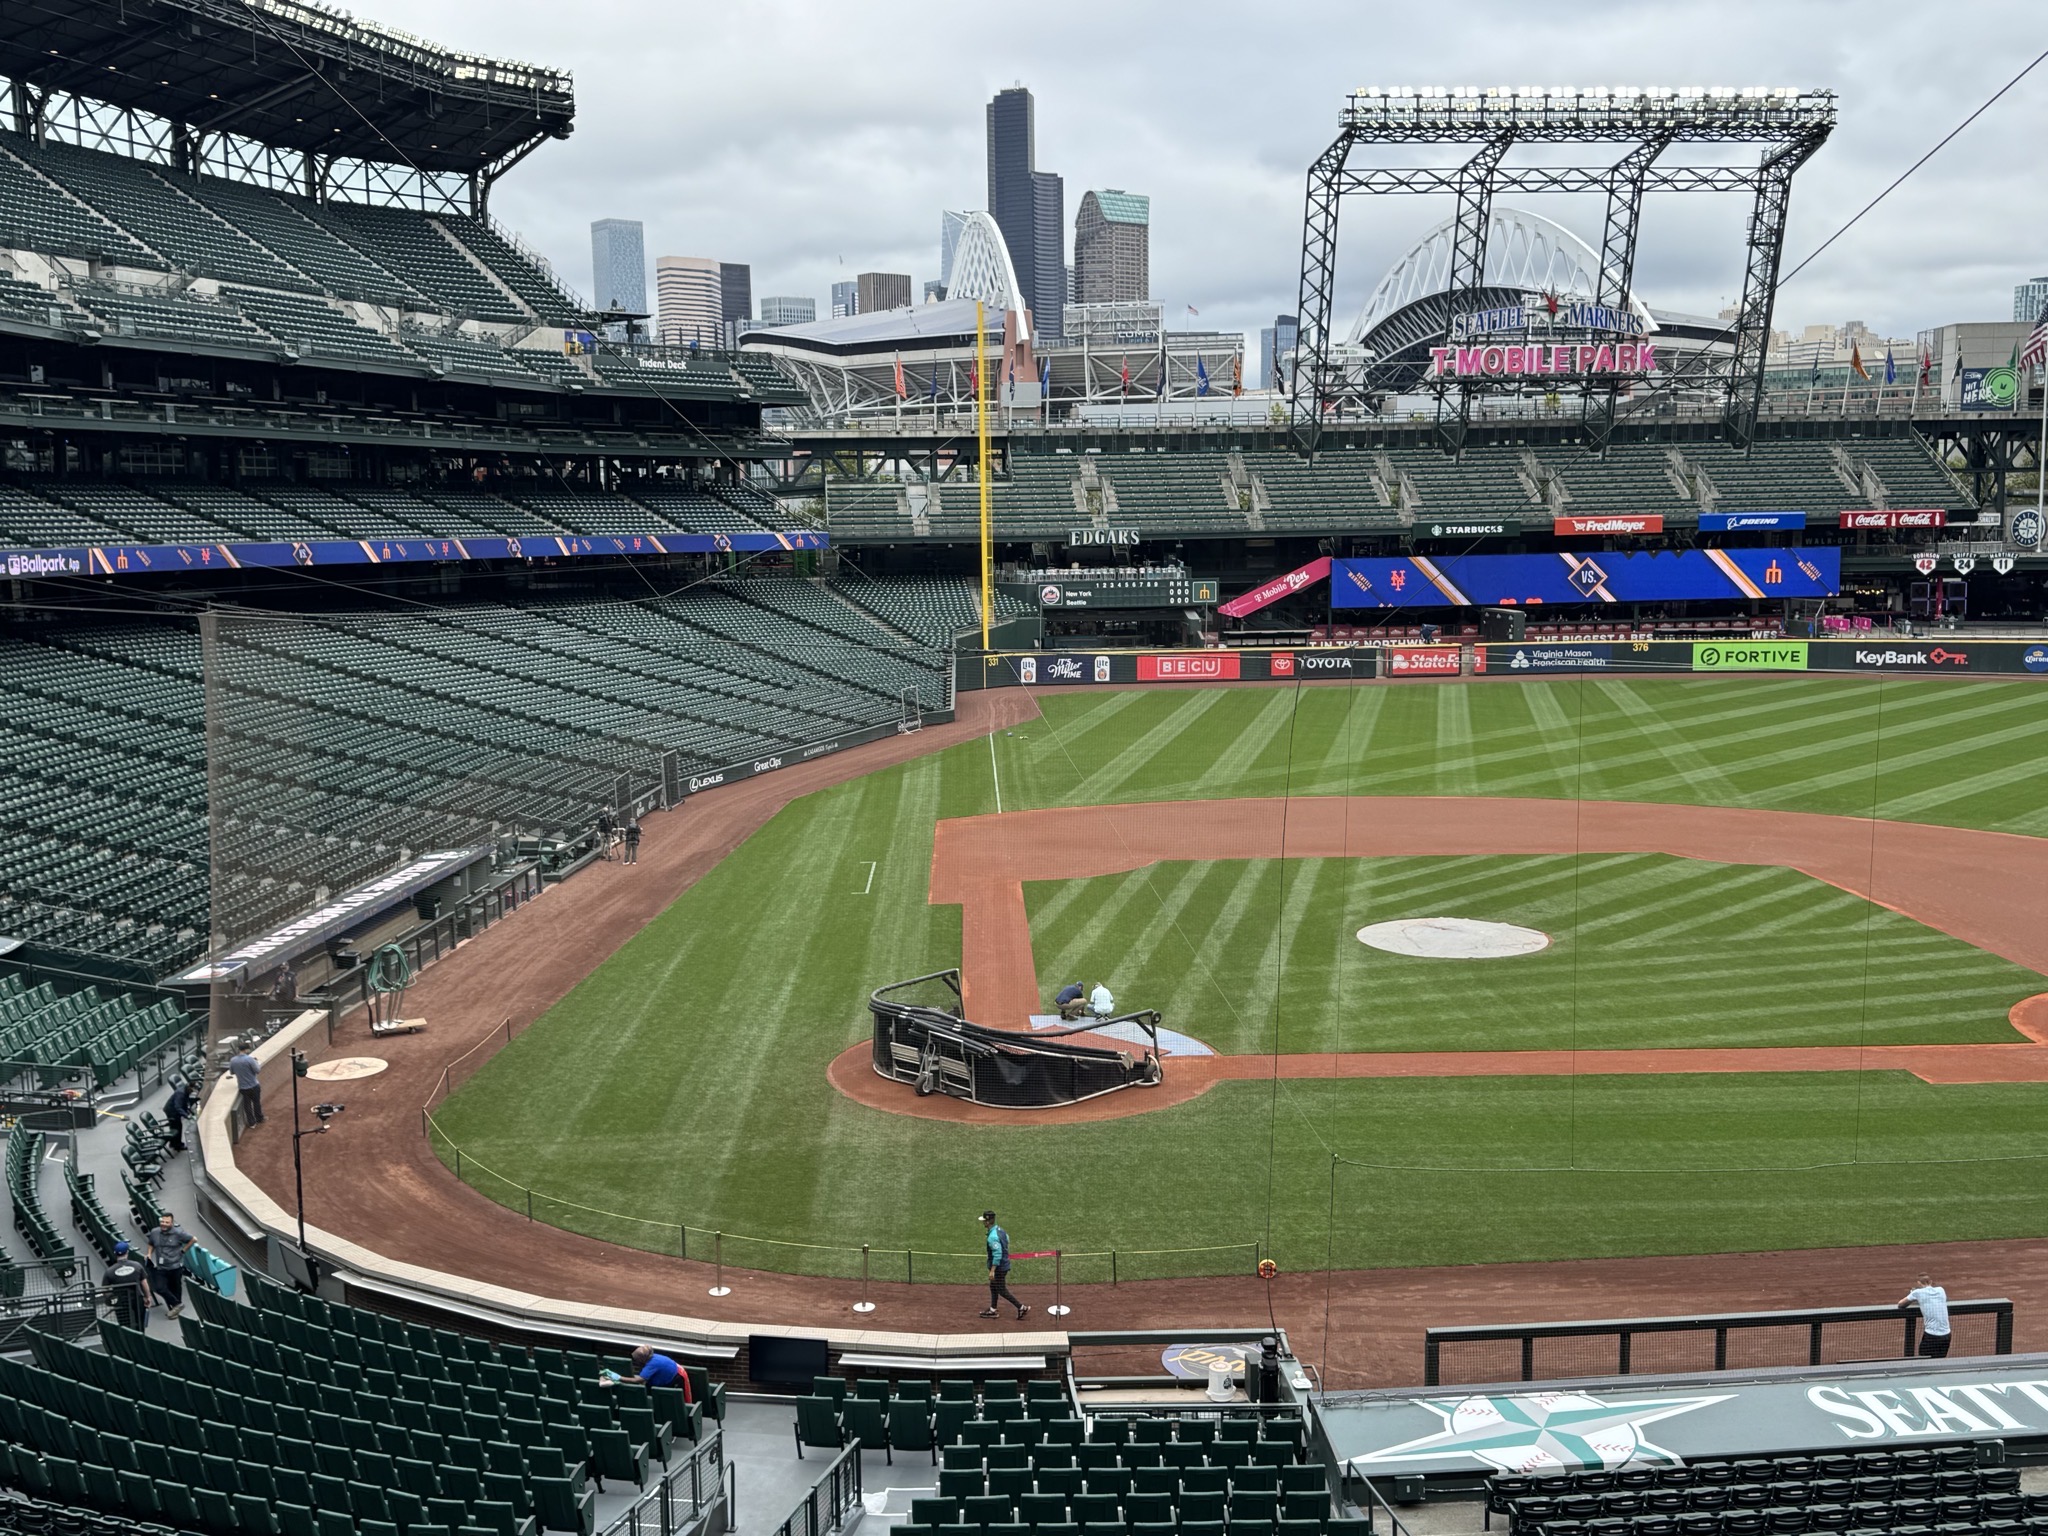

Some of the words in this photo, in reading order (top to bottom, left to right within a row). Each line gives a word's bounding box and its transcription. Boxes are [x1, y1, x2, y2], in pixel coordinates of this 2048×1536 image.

[1454, 306, 1526, 338] SEATTLE
[1568, 303, 1644, 335] MARINERS
[637, 357, 666, 369] Trident
[667, 358, 687, 370] Deck
[1430, 344, 1571, 376] T-MOBILE
[1576, 343, 1659, 373] PARK
[1965, 381, 1977, 391] HIT
[1739, 517, 1779, 526] BOEING
[1445, 525, 1503, 534] STARBUCKS
[20, 553, 67, 577] Ballpark
[1919, 560, 1933, 570] 42
[1958, 560, 1971, 570] 24
[1998, 560, 2008, 570] 11
[1581, 570, 1597, 583] VS.
[1262, 583, 1287, 599] Mobile
[1632, 643, 1649, 652] 376
[1532, 650, 1563, 660] Virginia
[1564, 649, 1592, 658] Mason
[1725, 650, 1801, 663] FORTIVE
[1855, 651, 1927, 666] KeyBank
[988, 657, 999, 667] 331
[1022, 661, 1035, 669] Lite
[1057, 658, 1072, 666] IT'S
[1096, 659, 1109, 668] Lite
[1533, 659, 1576, 667] Franciscan
[1578, 658, 1606, 667] Health
[1047, 662, 1082, 678] Miller
[754, 761, 769, 772] Great
[769, 757, 782, 769] Clips
[698, 773, 724, 787] LEXUS
[361, 860, 446, 892] WELCOME
[342, 891, 385, 903] TO
[270, 901, 365, 937] T-MOBILE
[223, 935, 297, 959] PARK
